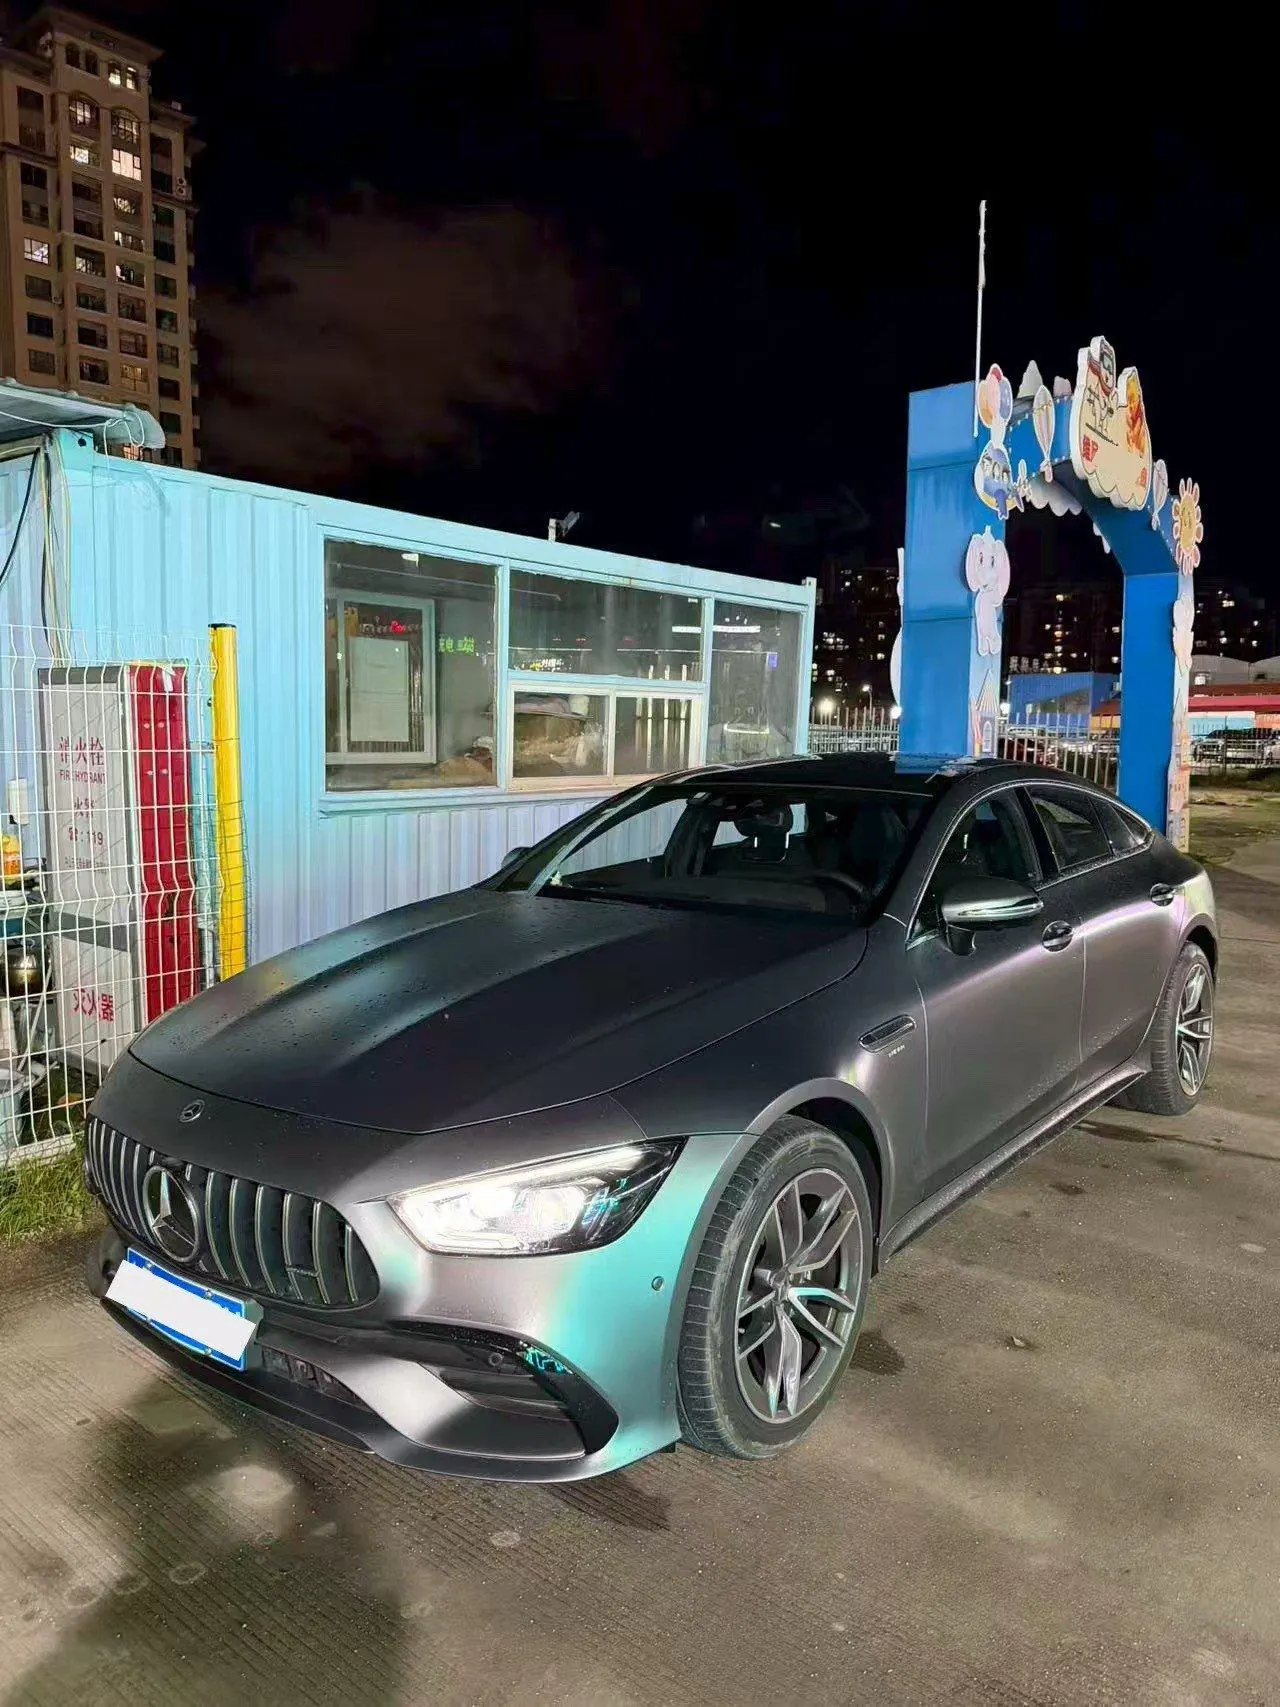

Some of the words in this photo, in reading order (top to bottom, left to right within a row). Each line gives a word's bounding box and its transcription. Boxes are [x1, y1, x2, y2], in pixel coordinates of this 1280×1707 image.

[59, 735, 105, 767] 消火栓
[60, 768, 73, 781] FIR
[71, 986, 114, 1022] 灭火器
